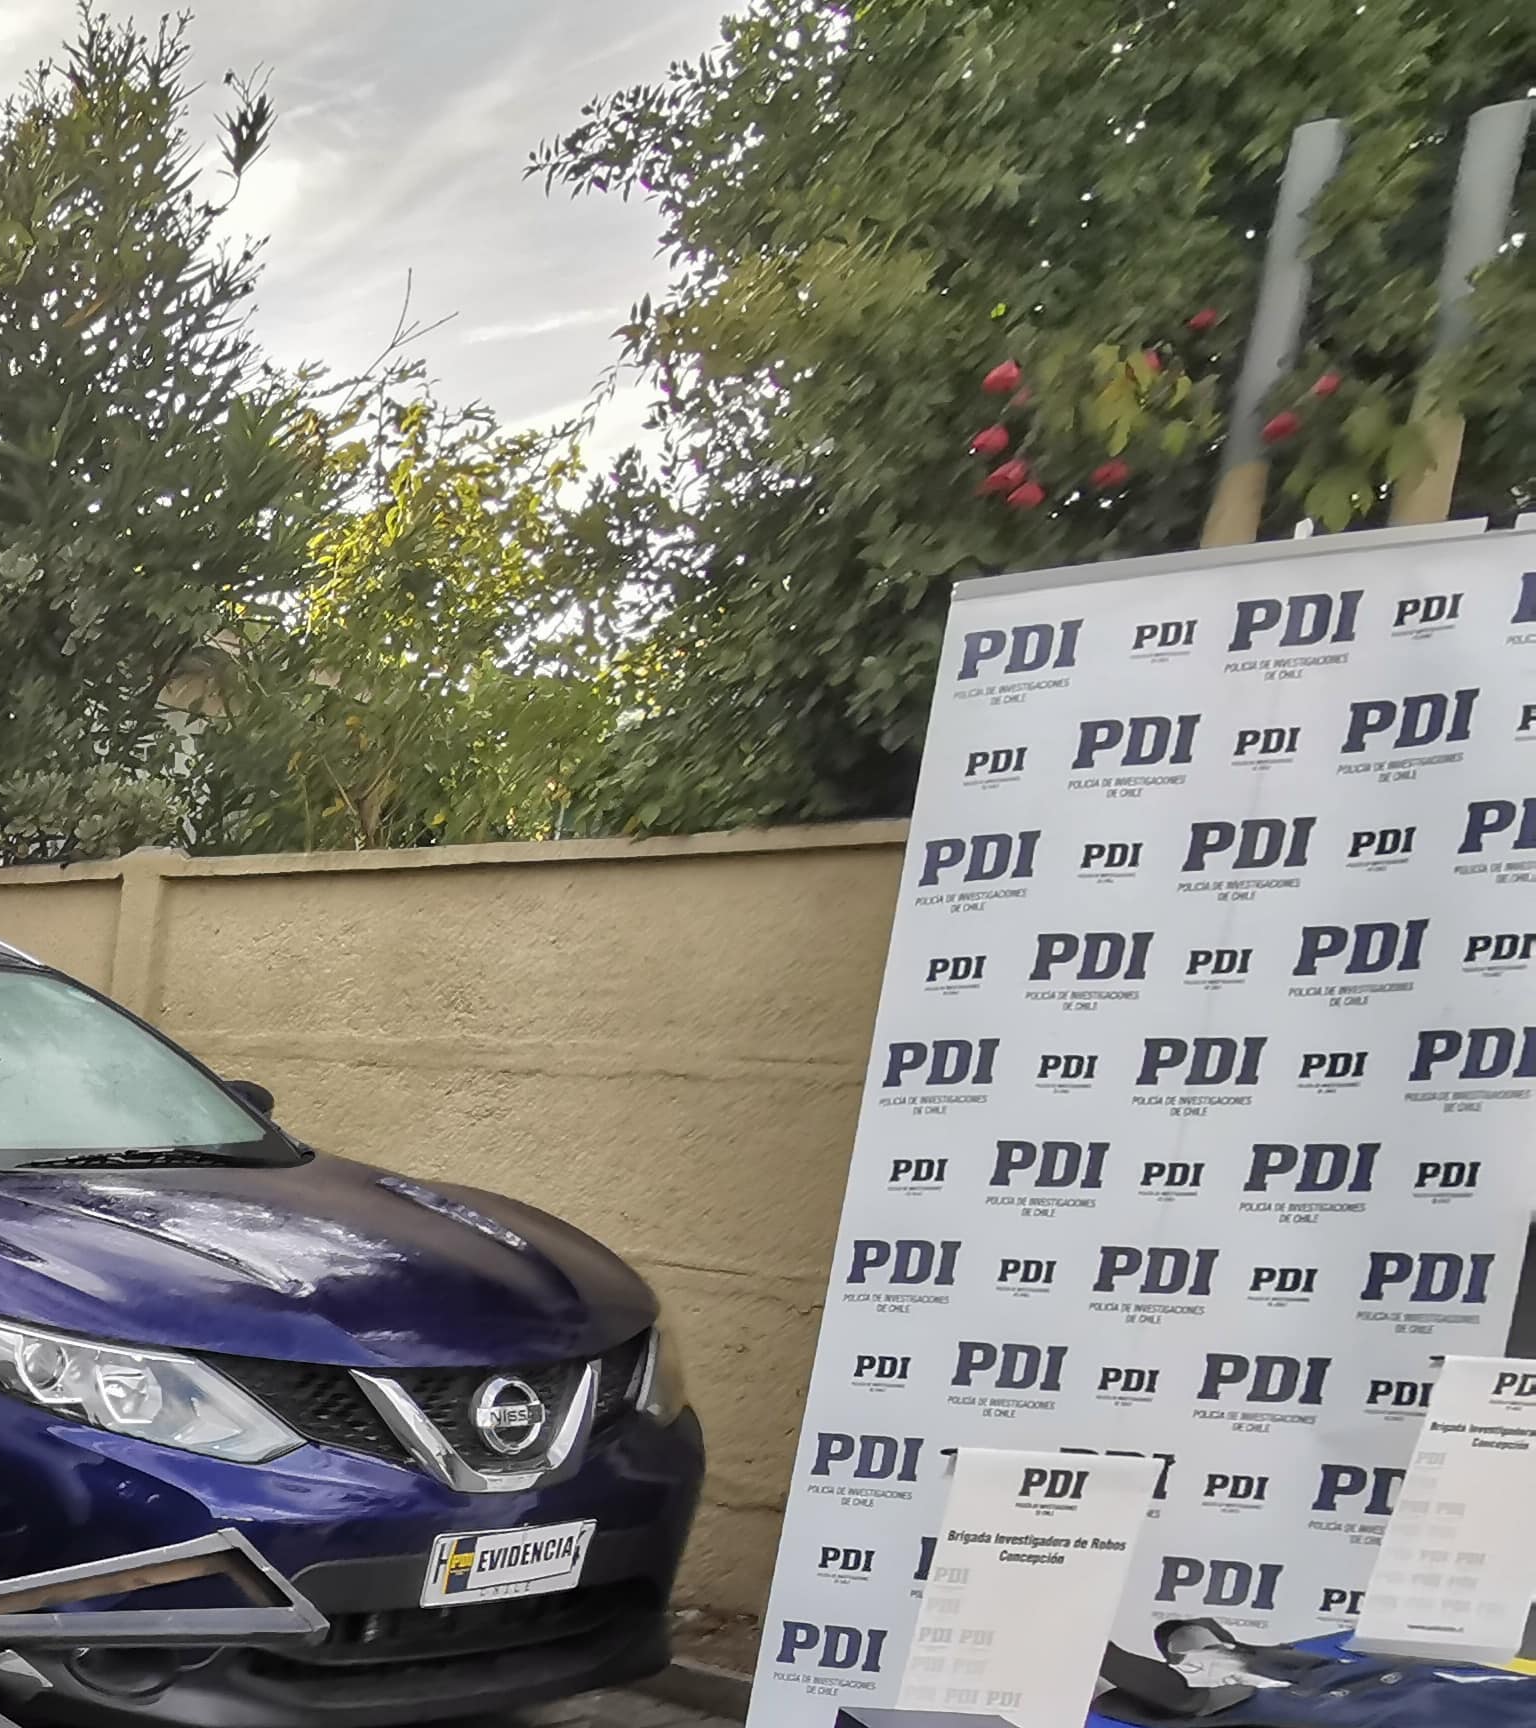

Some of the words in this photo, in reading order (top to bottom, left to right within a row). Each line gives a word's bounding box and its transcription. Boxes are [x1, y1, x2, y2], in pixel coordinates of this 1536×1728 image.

[1228, 590, 1364, 652] PDI
[1393, 593, 1464, 627] PDI
[957, 619, 1084, 681] PDI
[1132, 620, 1198, 650] PDI
[1340, 688, 1480, 753] PDI
[1072, 714, 1201, 769] PDI
[1233, 727, 1301, 756] PDI
[965, 747, 1028, 777] PDI
[918, 830, 1041, 887] PDI
[1080, 843, 1143, 868] PDI
[1181, 817, 1317, 872] PDI
[1347, 826, 1416, 858] PDI
[1029, 932, 1154, 980] PDI
[1186, 949, 1253, 975] PDI
[1292, 919, 1430, 976] PDI
[926, 955, 987, 982] PDI
[882, 1038, 1000, 1088] PDI
[1037, 1055, 1098, 1079] PDI
[1136, 1037, 1268, 1085] PDI
[1299, 1052, 1368, 1078] PDI
[889, 1158, 949, 1182] PDI
[989, 1140, 1110, 1188] PDI
[1140, 1162, 1205, 1187] PDI
[1243, 1143, 1381, 1192] PDI
[1414, 1162, 1481, 1188] PDI
[846, 1240, 962, 1285] PDI
[997, 1259, 1057, 1284] PDI
[1092, 1246, 1219, 1296] PDI
[1360, 1252, 1496, 1304] PDI
[1249, 1267, 1318, 1293] PDI
[854, 1355, 911, 1379] PDI
[951, 1341, 1068, 1391] PDI
[1097, 1367, 1160, 1393] PDI
[1196, 1353, 1332, 1405] PDI
[1492, 1372, 1536, 1396] PD
[810, 1432, 924, 1482] PDI
[1019, 1468, 1090, 1499] PDI
[1203, 1474, 1269, 1500] PDI
[1312, 1464, 1406, 1516] PD
[478, 1536, 574, 1573] EVIDENCIA
[947, 1530, 991, 1546] Brigada
[995, 1533, 1070, 1548] Investigadora
[1073, 1536, 1088, 1548] de
[1090, 1537, 1126, 1551] Robos
[999, 1550, 1064, 1565] Concepción
[818, 1546, 876, 1572] PDI
[1154, 1556, 1284, 1610] PDI
[776, 1620, 888, 1672] PDI
